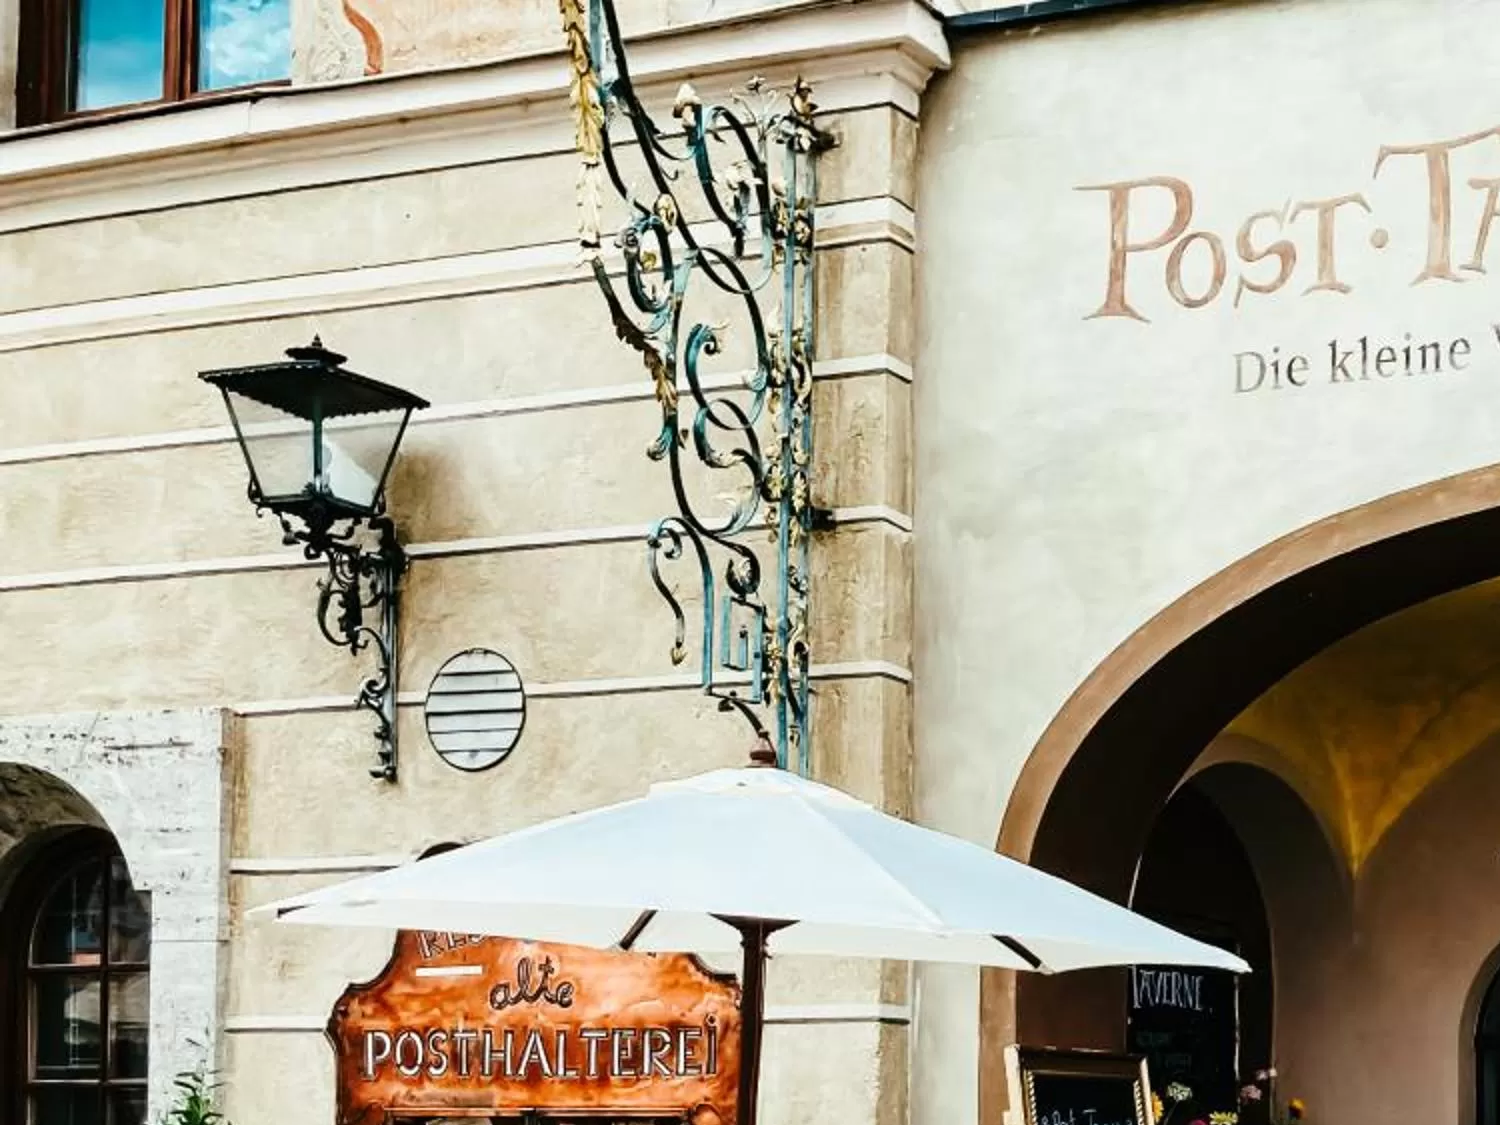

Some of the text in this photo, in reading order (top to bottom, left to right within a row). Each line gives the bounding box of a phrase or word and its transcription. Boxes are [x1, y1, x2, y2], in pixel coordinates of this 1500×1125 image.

[1232, 350, 1310, 396] Die
[1327, 333, 1473, 384] kleine
[488, 955, 576, 1011] alte
[1127, 964, 1204, 1012] TAVERNE
